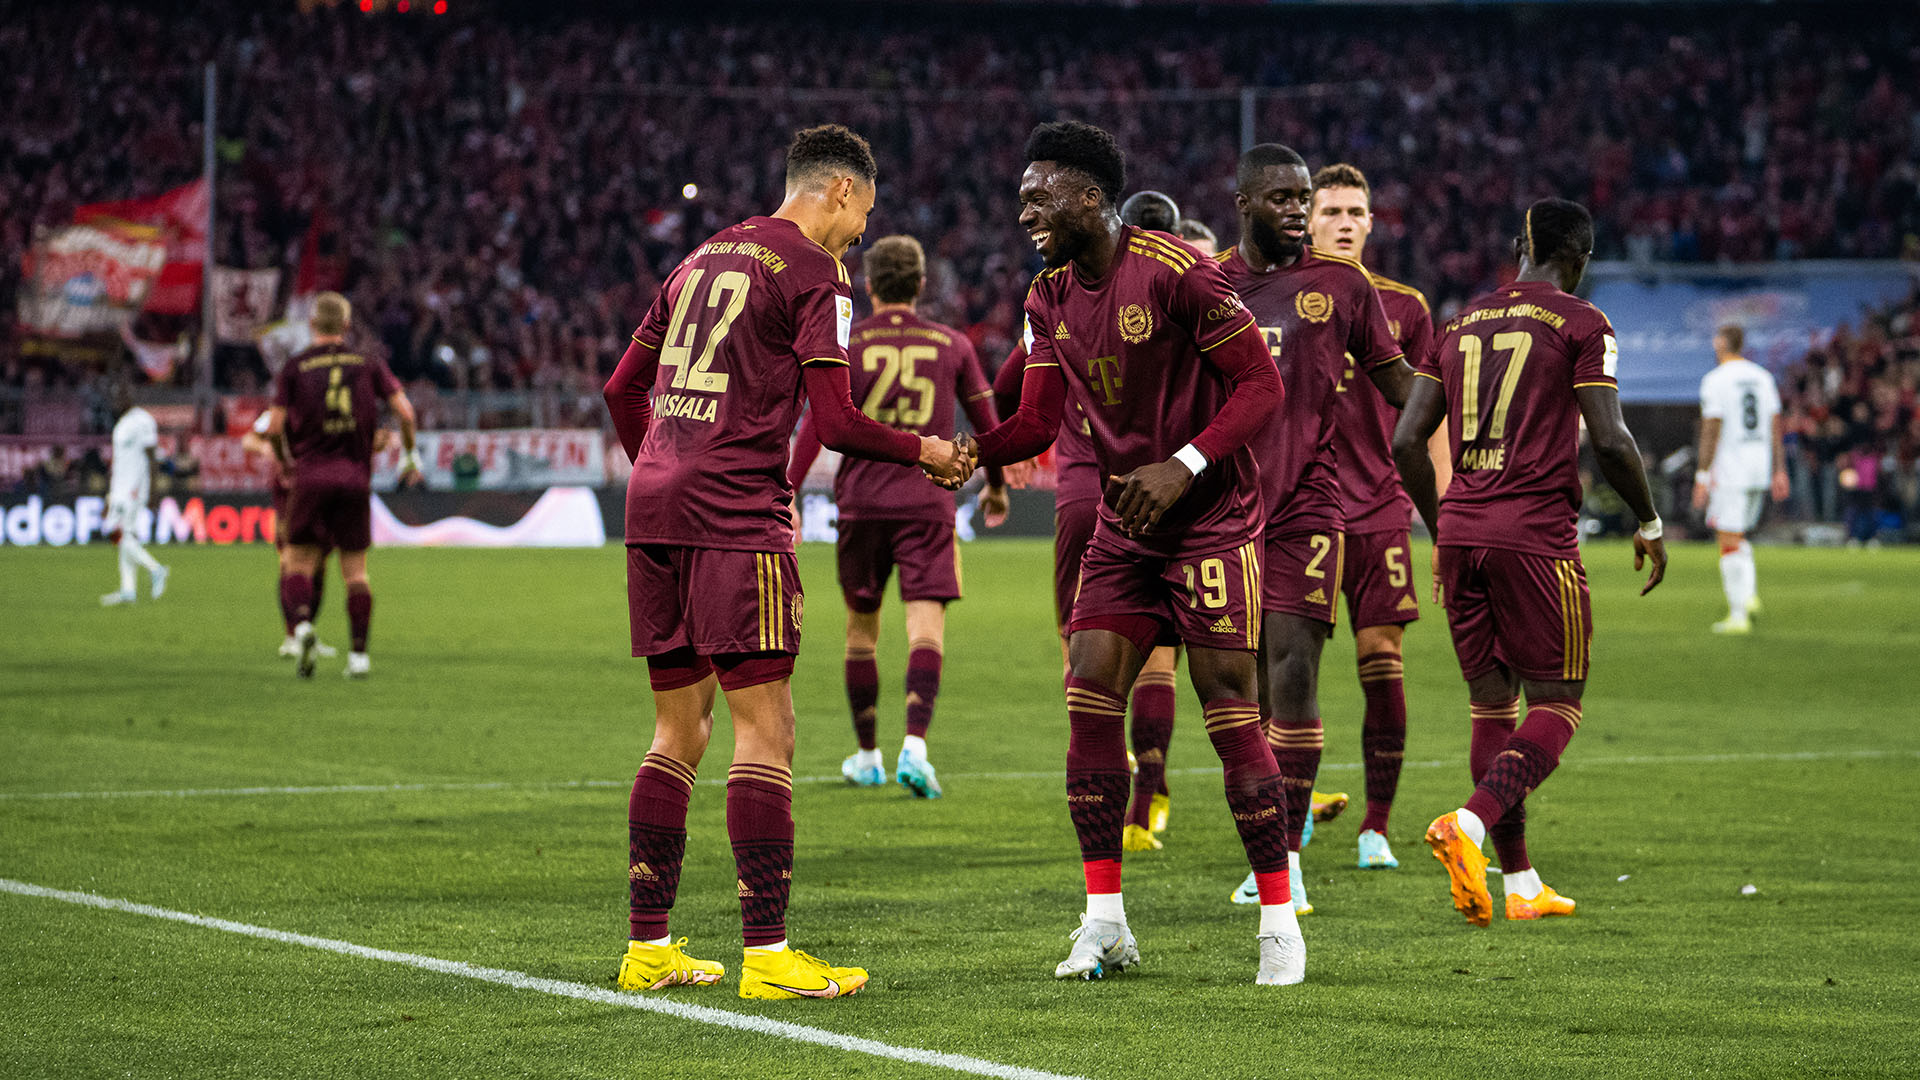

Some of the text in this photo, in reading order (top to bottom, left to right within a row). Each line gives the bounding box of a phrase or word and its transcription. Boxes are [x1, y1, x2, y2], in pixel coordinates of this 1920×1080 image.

[660, 268, 751, 393] 42
[1461, 307, 1505, 327] BAYERN
[861, 344, 938, 426] 25
[1459, 331, 1533, 441] 17
[653, 393, 718, 423] MUSIALA
[1742, 391, 1759, 430] 8
[1462, 443, 1505, 471] MANÉ
[1304, 534, 1331, 579] 2
[1384, 546, 1407, 588] 5
[1182, 557, 1228, 609] 19
[1209, 624, 1237, 634] adidas
